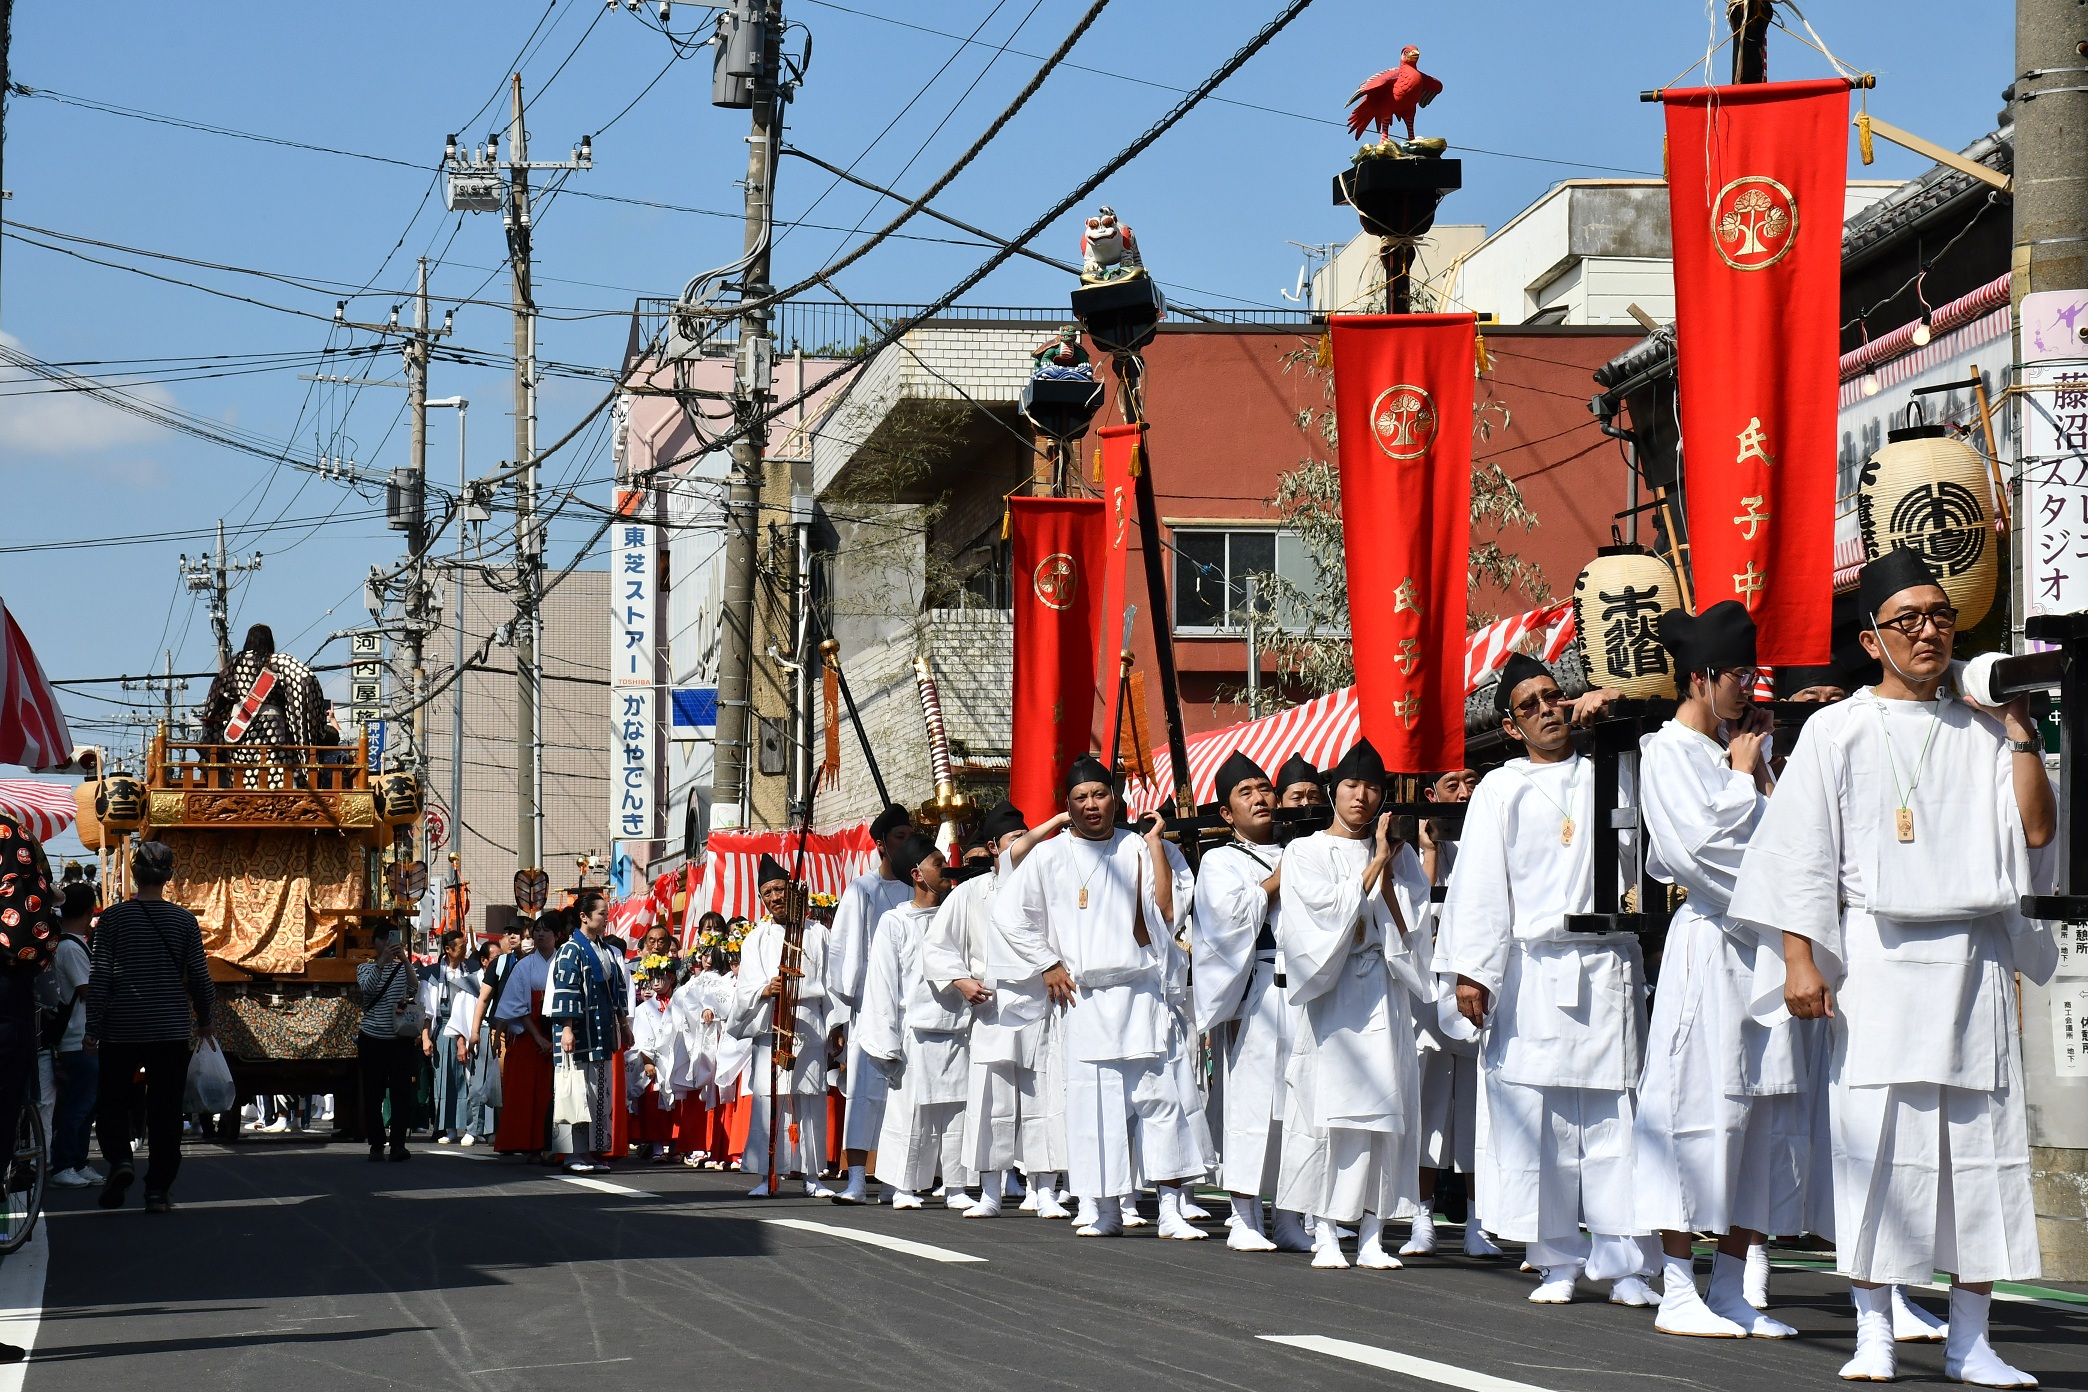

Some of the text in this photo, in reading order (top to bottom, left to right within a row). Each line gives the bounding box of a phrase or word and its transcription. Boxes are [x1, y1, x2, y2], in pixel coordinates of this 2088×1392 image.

[1733, 416, 1776, 611] 氏子中
[2038, 458, 2071, 602] スタジオ
[623, 526, 646, 673] 東芝ストアー
[1392, 575, 1424, 730] 氏子中
[367, 722, 381, 771] 押ボタン
[621, 695, 644, 836] かなやでんき
